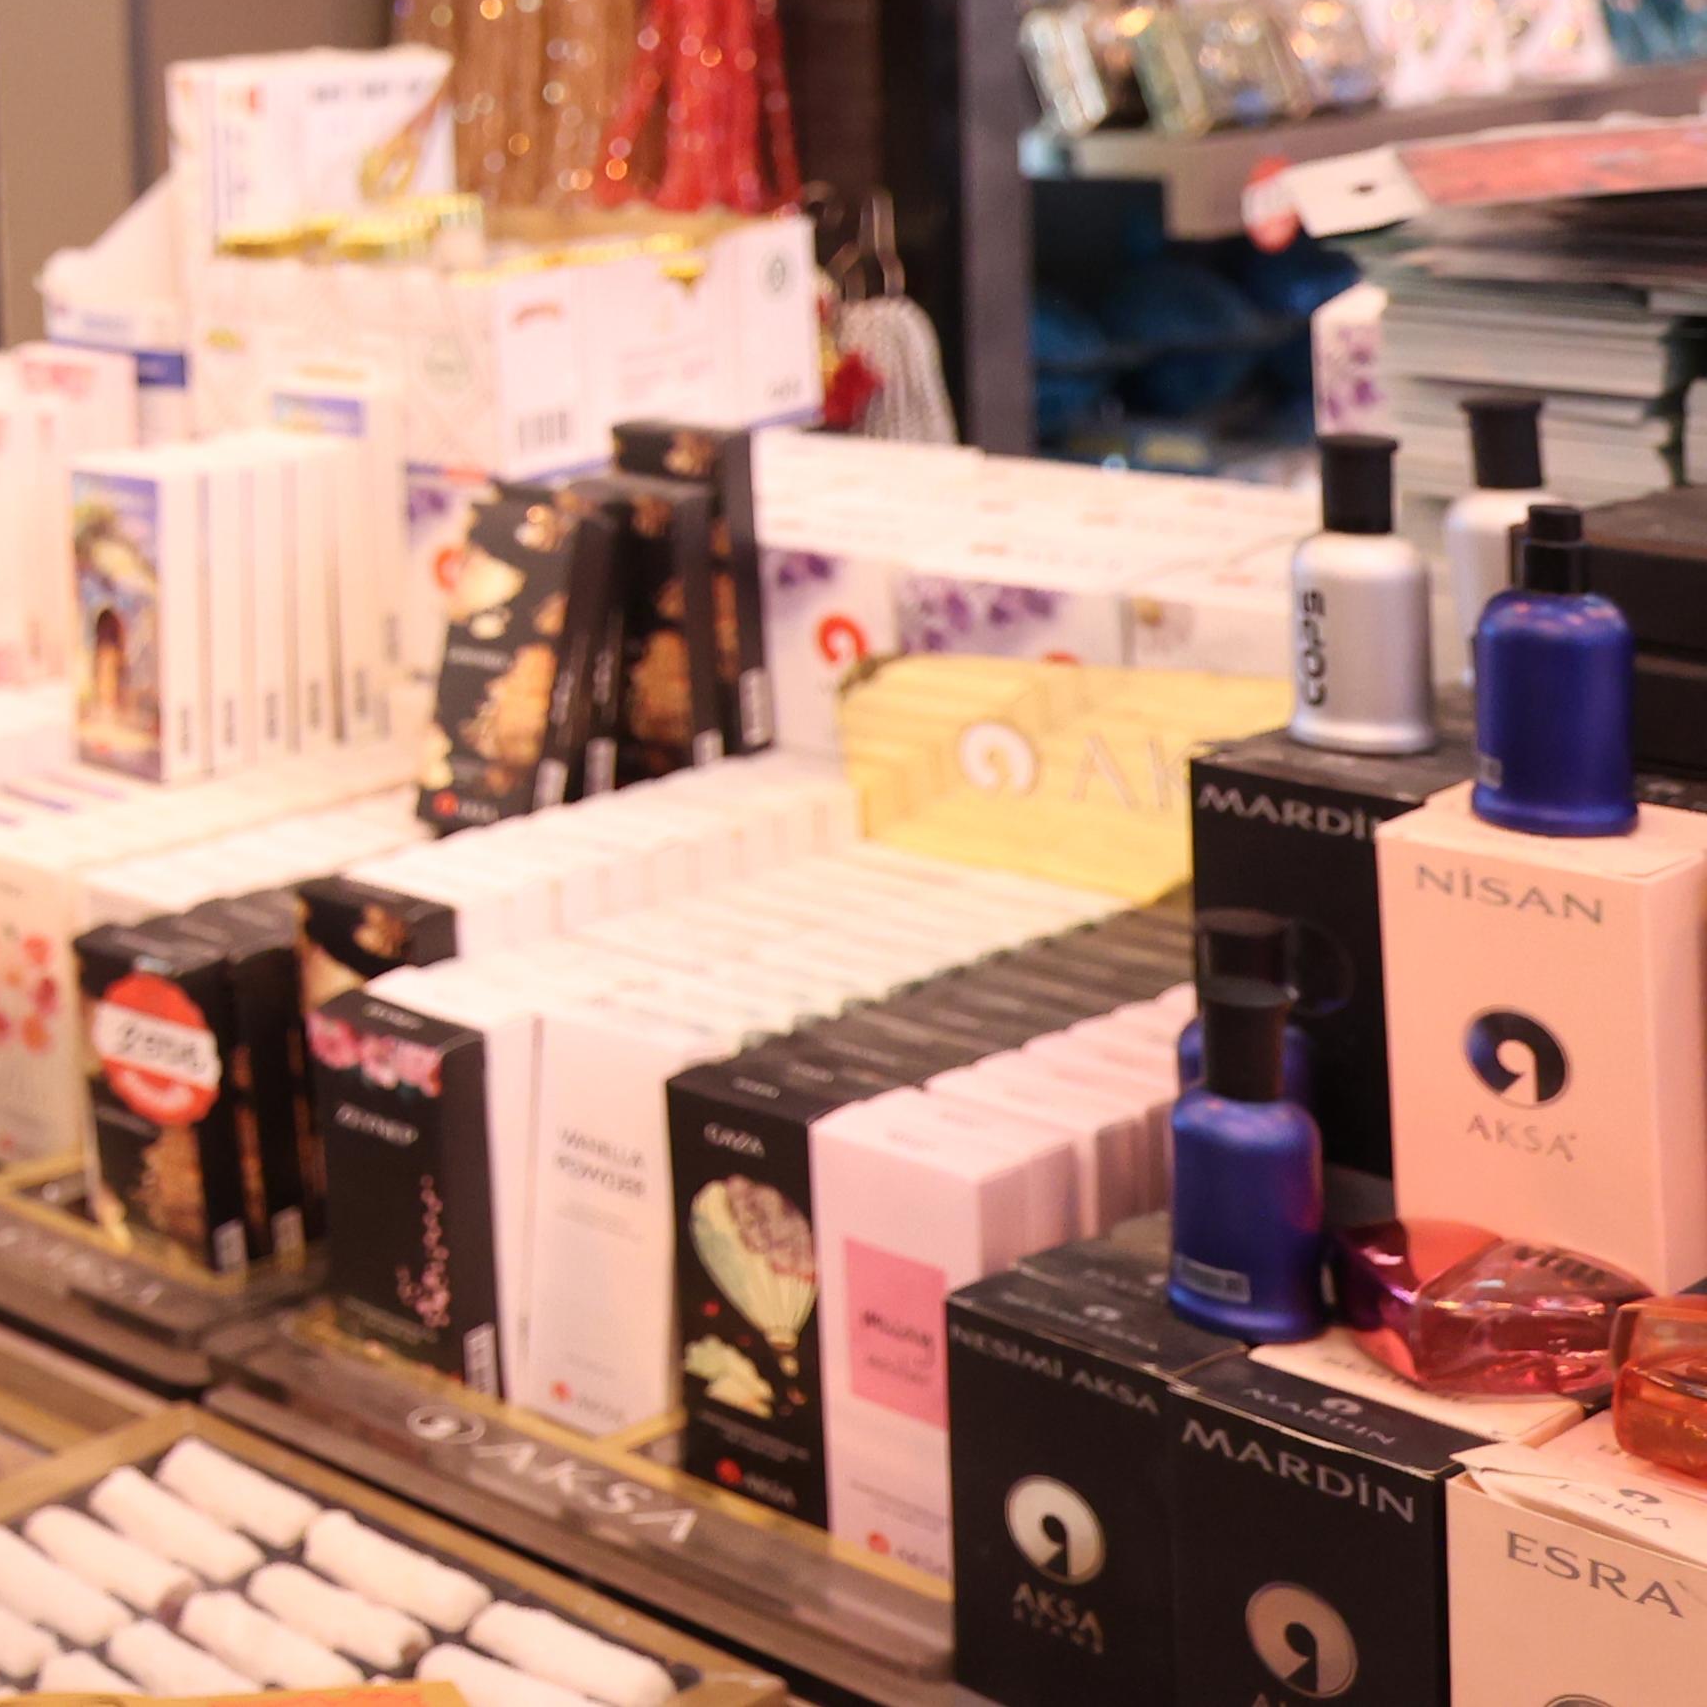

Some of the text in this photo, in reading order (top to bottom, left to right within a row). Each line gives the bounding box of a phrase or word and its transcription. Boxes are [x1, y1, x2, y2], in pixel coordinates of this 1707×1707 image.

[1415, 862, 1604, 926] NİSAN
[1468, 1114, 1575, 1162] AKSA
[1072, 1369, 1162, 1417] AKSA
[473, 1442, 698, 1543] AKSA
[1181, 1417, 1415, 1524] MARDİN
[1505, 1530, 1685, 1619] ESRA
